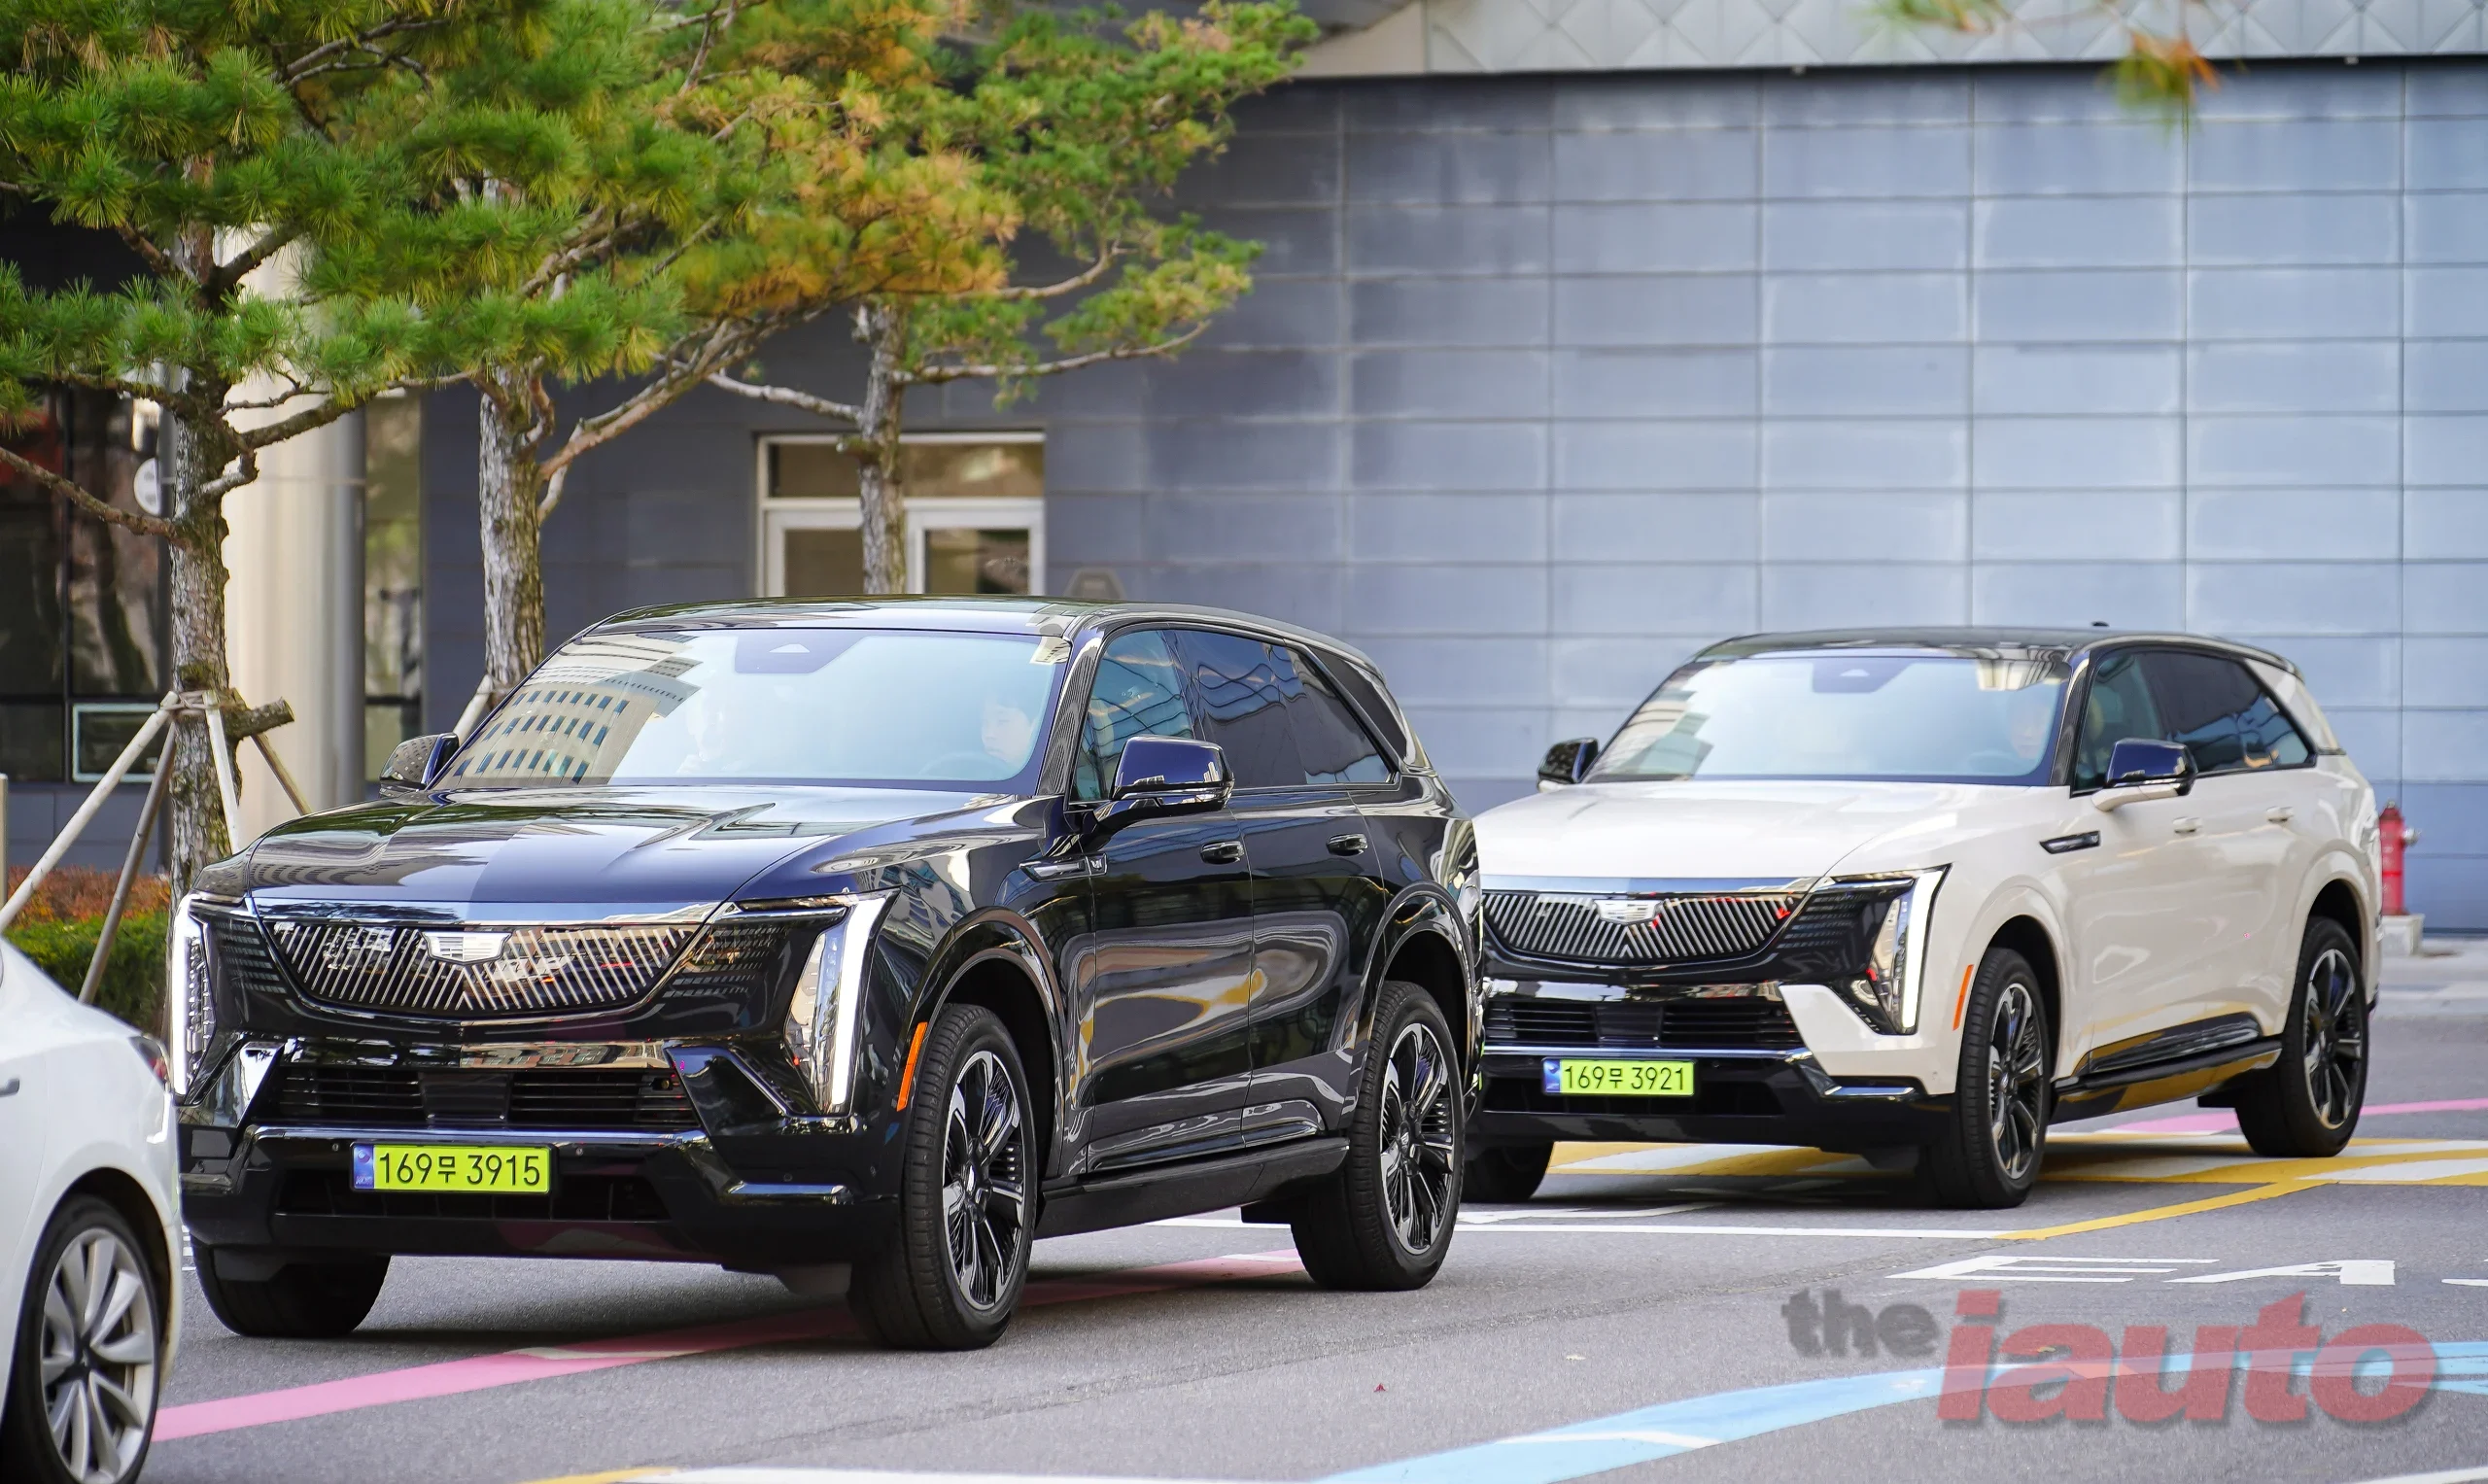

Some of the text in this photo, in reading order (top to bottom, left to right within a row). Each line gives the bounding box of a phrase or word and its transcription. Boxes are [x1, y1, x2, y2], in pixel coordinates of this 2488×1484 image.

[1565, 1065, 1683, 1090] 169무 3921
[379, 1153, 540, 1187] 169무 3915
[1883, 1255, 2488, 1287] EA
